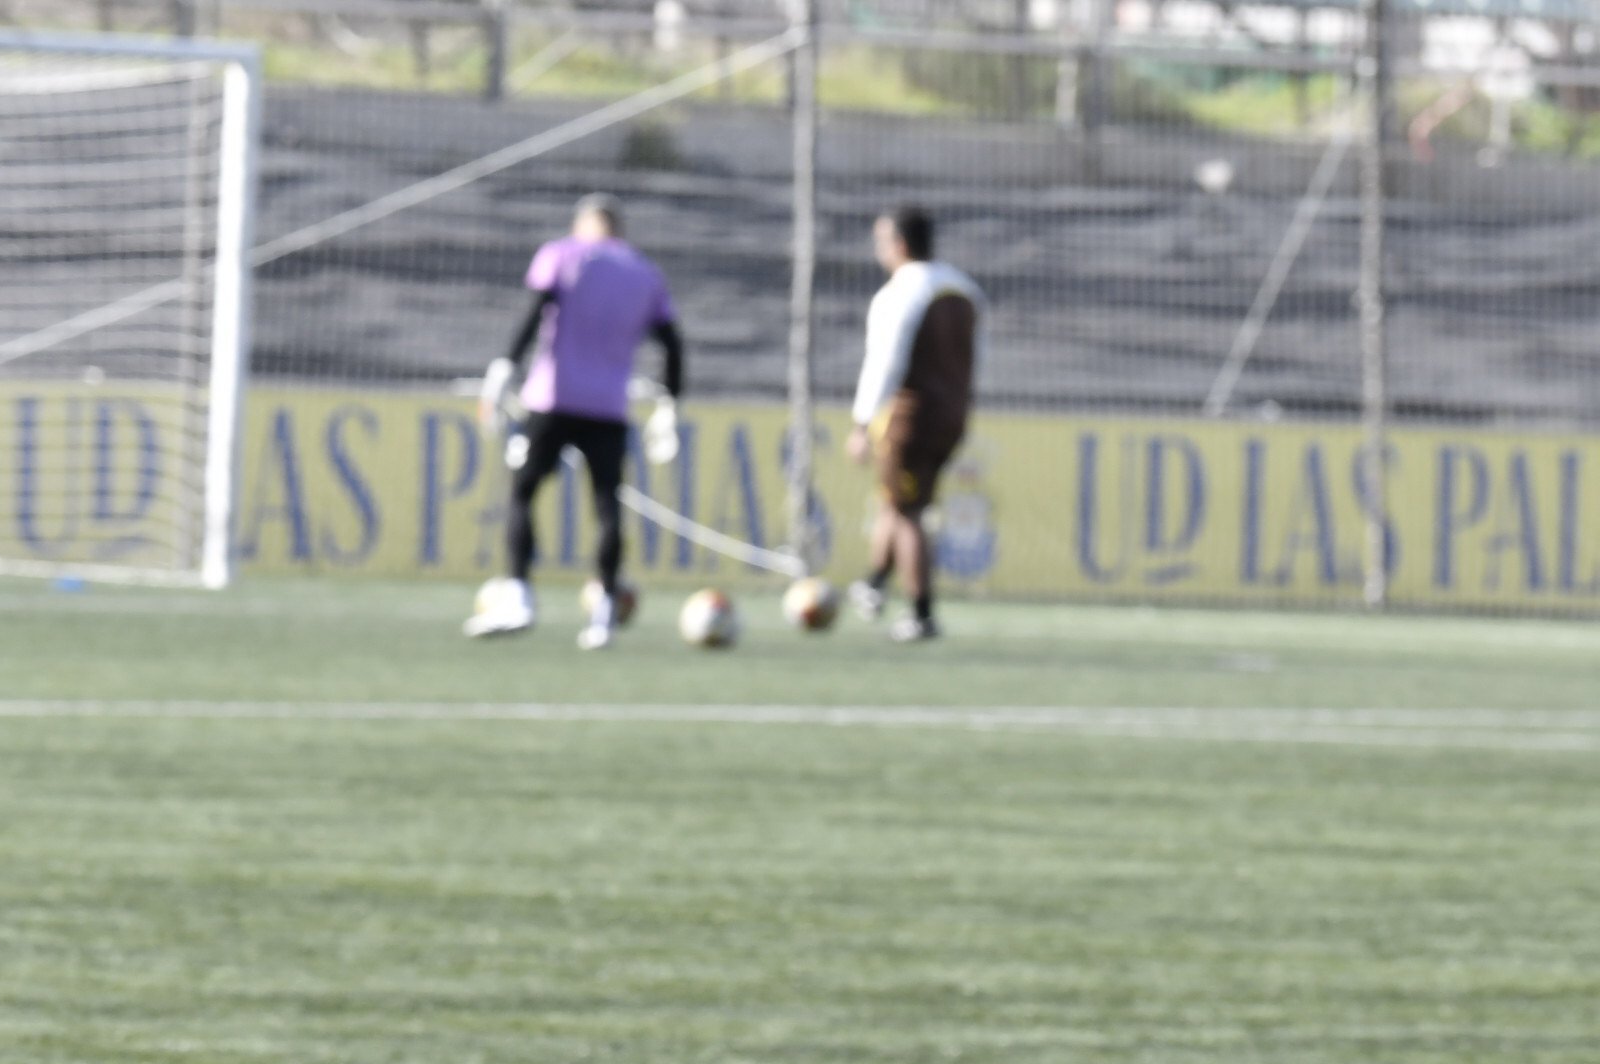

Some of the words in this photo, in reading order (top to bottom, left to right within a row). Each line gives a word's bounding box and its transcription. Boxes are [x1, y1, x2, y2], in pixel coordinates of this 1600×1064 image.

[12, 397, 162, 562] UD
[230, 405, 382, 568] AS
[1076, 430, 1208, 584] UD
[1238, 438, 1400, 588] LAS
